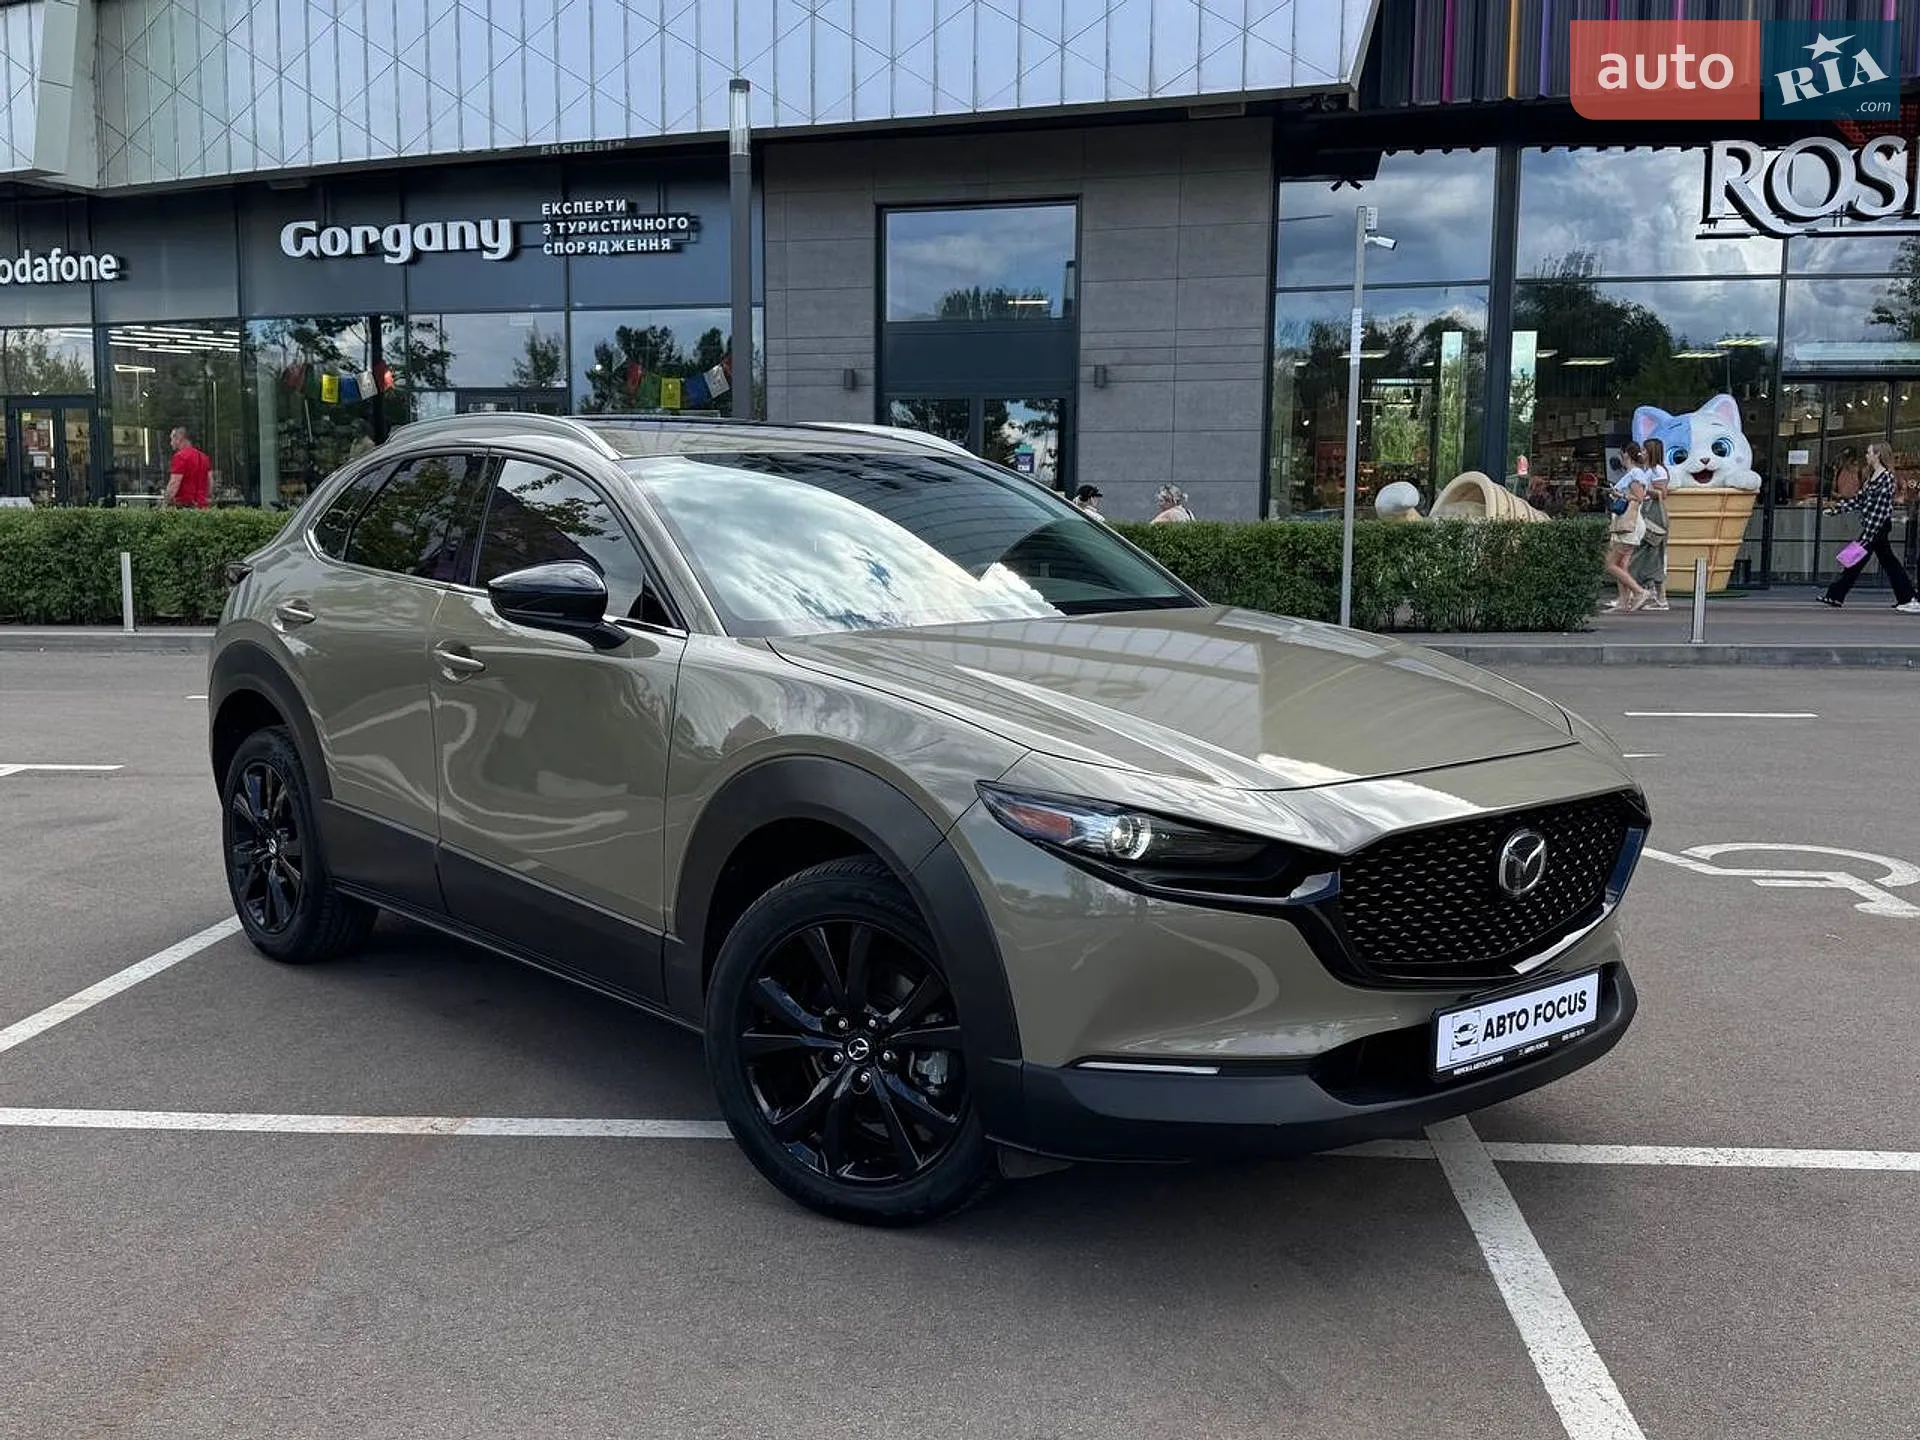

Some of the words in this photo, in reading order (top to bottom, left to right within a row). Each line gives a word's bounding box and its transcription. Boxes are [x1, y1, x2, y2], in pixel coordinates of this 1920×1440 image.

[541, 199, 627, 215] ЕКСПЕРТИ
[556, 217, 689, 234] ТУРИСТИЧНОГО
[280, 218, 513, 265] Gorgany
[543, 238, 672, 255] СПОРЯДЖЕННЯ
[0, 247, 117, 284] odafone
[1482, 1007, 1530, 1042] АВТО
[1533, 989, 1588, 1027] FOCUS
